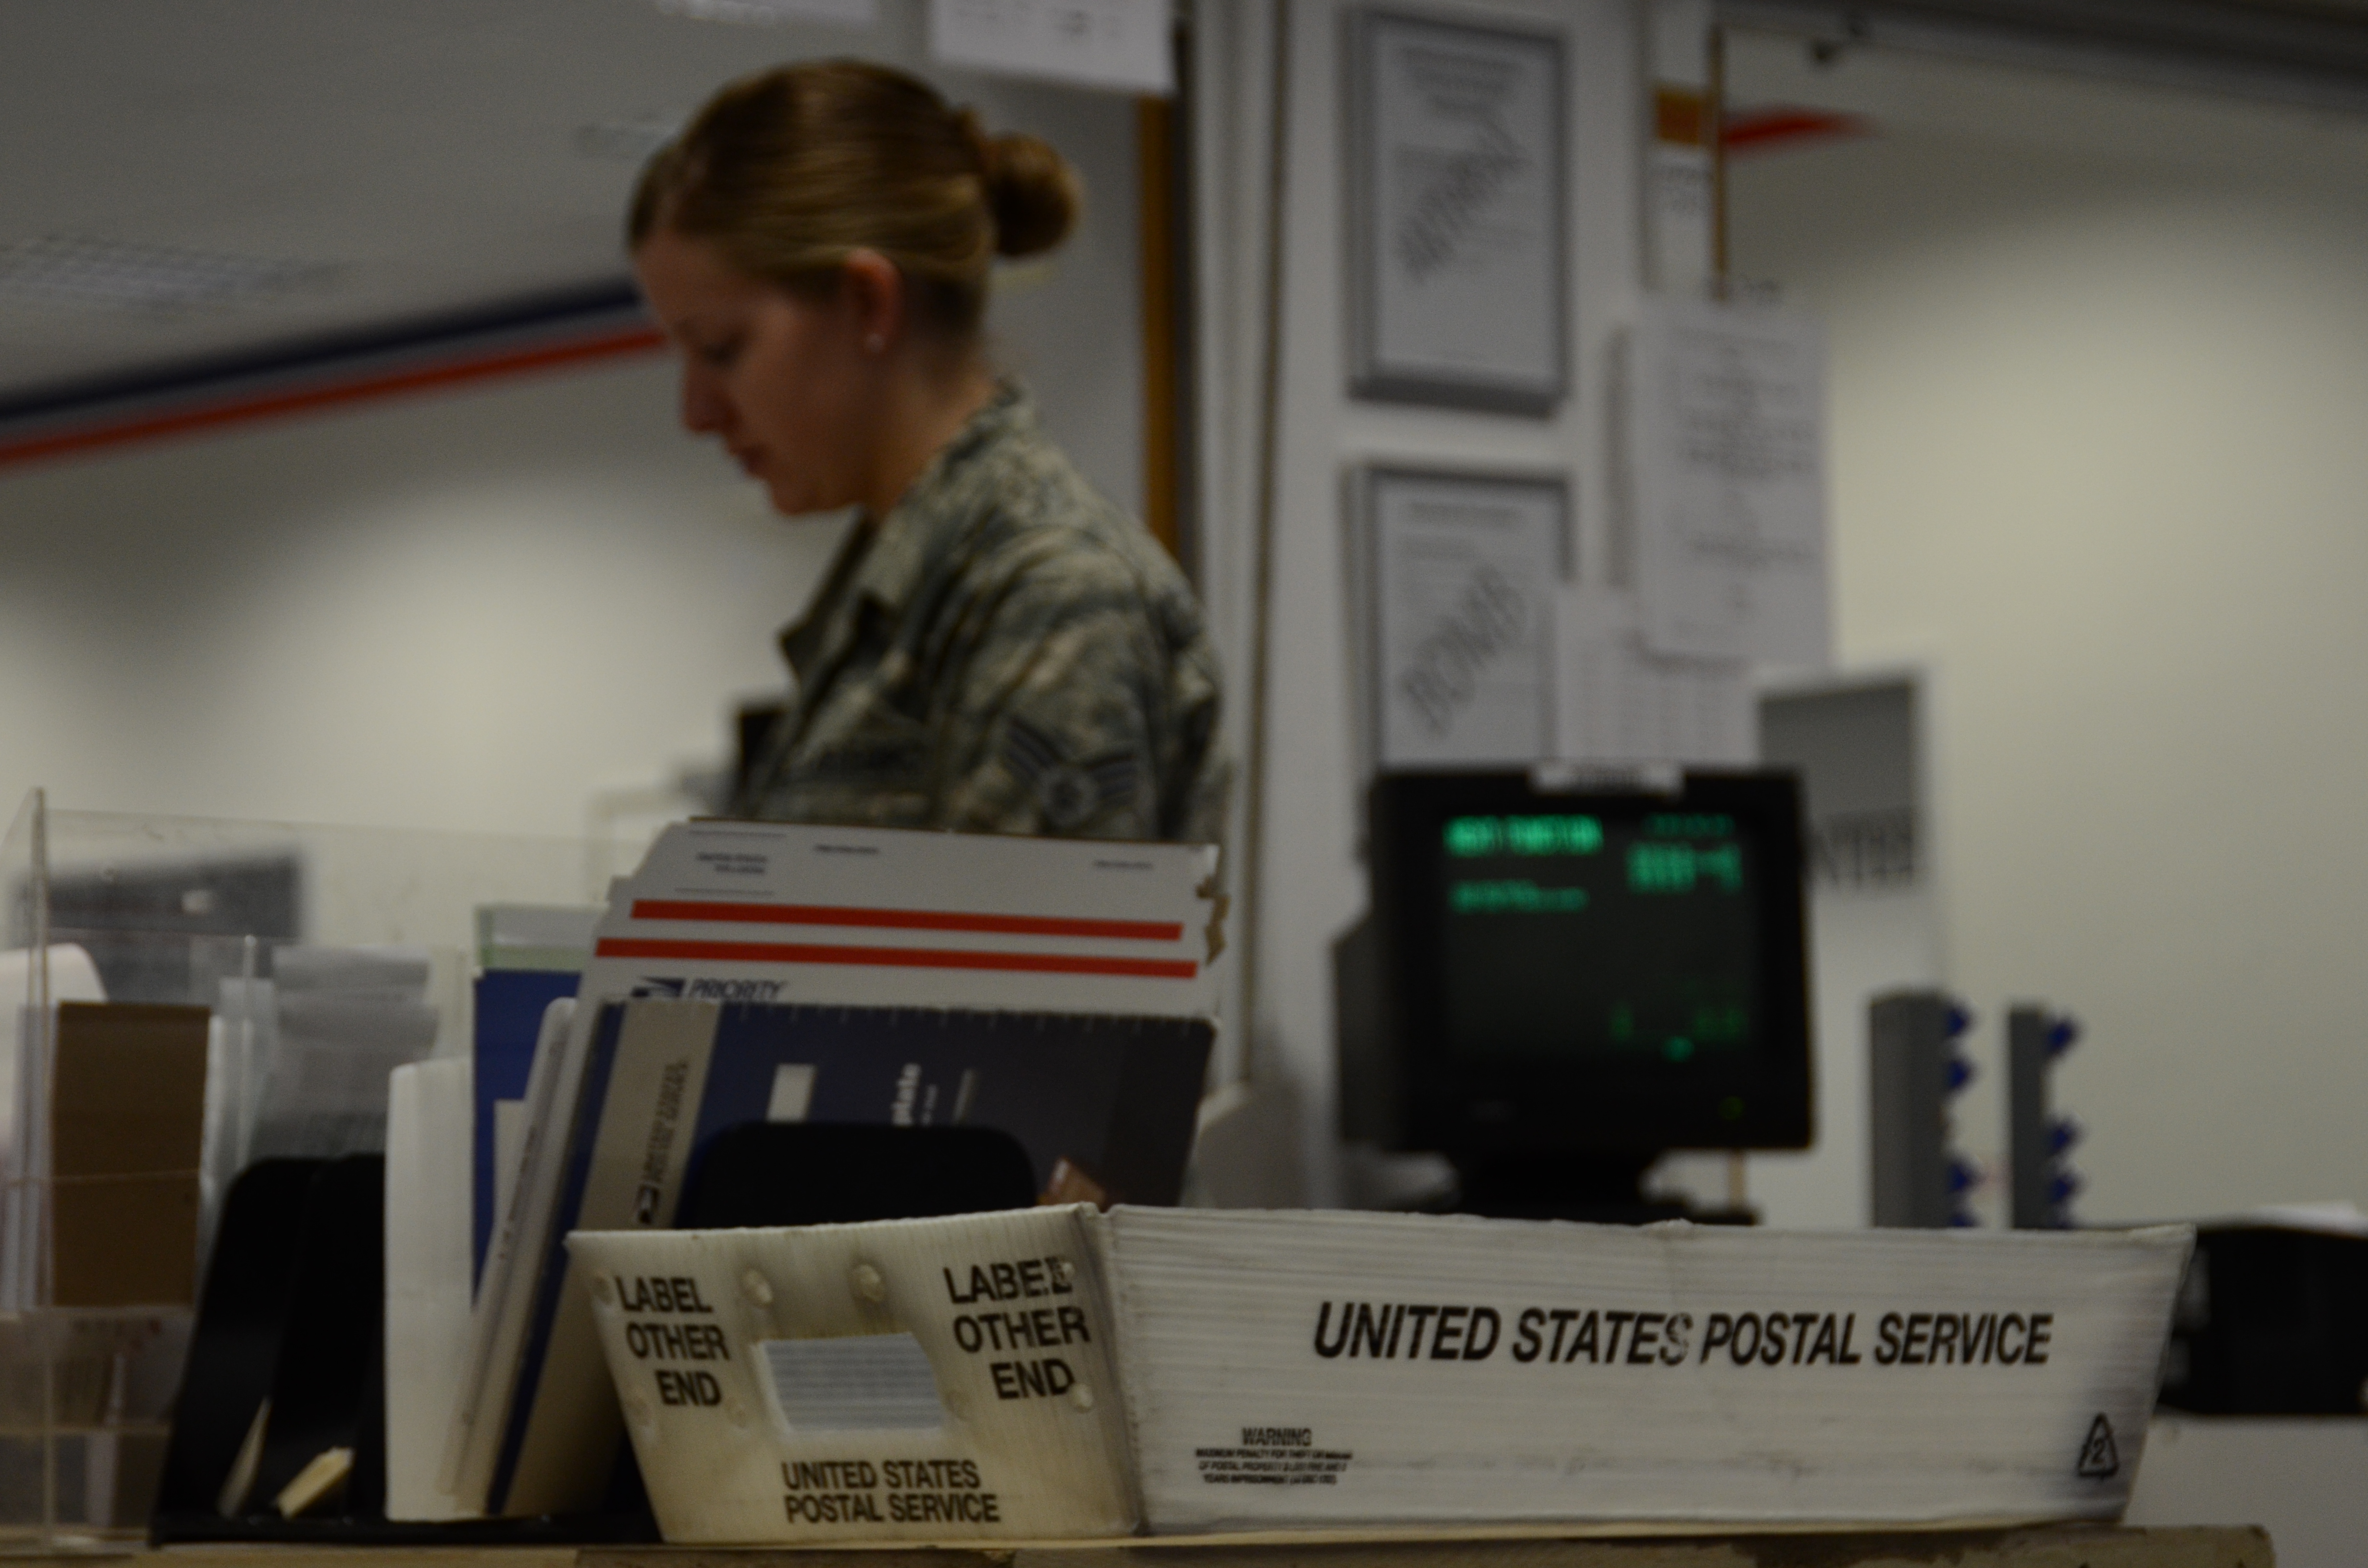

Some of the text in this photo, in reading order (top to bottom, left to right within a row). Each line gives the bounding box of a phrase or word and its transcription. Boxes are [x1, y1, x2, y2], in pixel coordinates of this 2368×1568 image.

[689, 978, 786, 1000] PRIORITY
[616, 1276, 713, 1313] LABEL
[944, 1256, 1073, 1303] LABEL
[627, 1323, 730, 1360] OTHER
[954, 1306, 1091, 1353] OTHER
[1314, 1302, 2053, 1366] UNITED STATES POSTAL SERVICE
[655, 1370, 722, 1407] END
[991, 1359, 1075, 1400] END
[1242, 1428, 1311, 1446] WARNING
[783, 1460, 980, 1490] UNITED STATES
[785, 1493, 1000, 1523] POSTAL SERVICE
